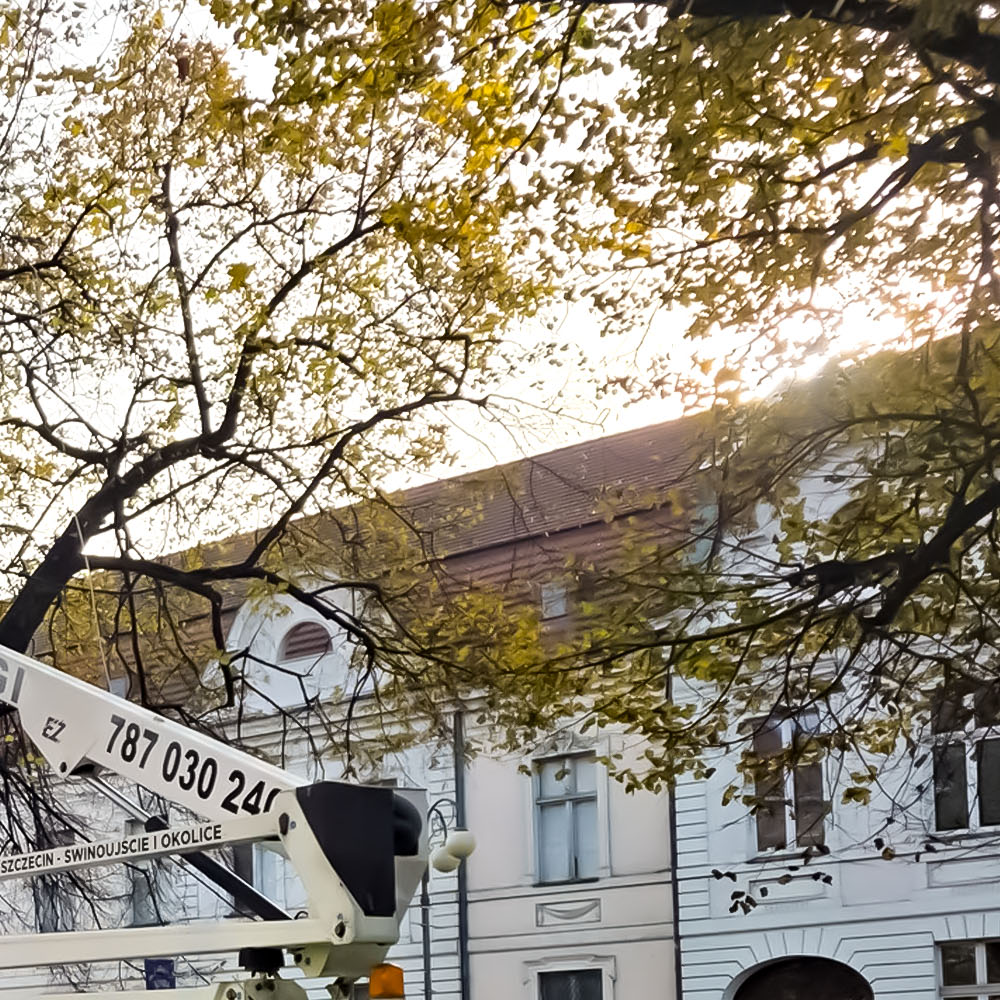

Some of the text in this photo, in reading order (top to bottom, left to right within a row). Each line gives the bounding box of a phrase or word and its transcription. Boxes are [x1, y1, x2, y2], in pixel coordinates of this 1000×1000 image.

[106, 714, 159, 769] 787
[162, 741, 217, 799] 030
[1, 852, 54, 873] SZCZECIN
[153, 836, 158, 850] I
[161, 824, 222, 847] OKOLICE
